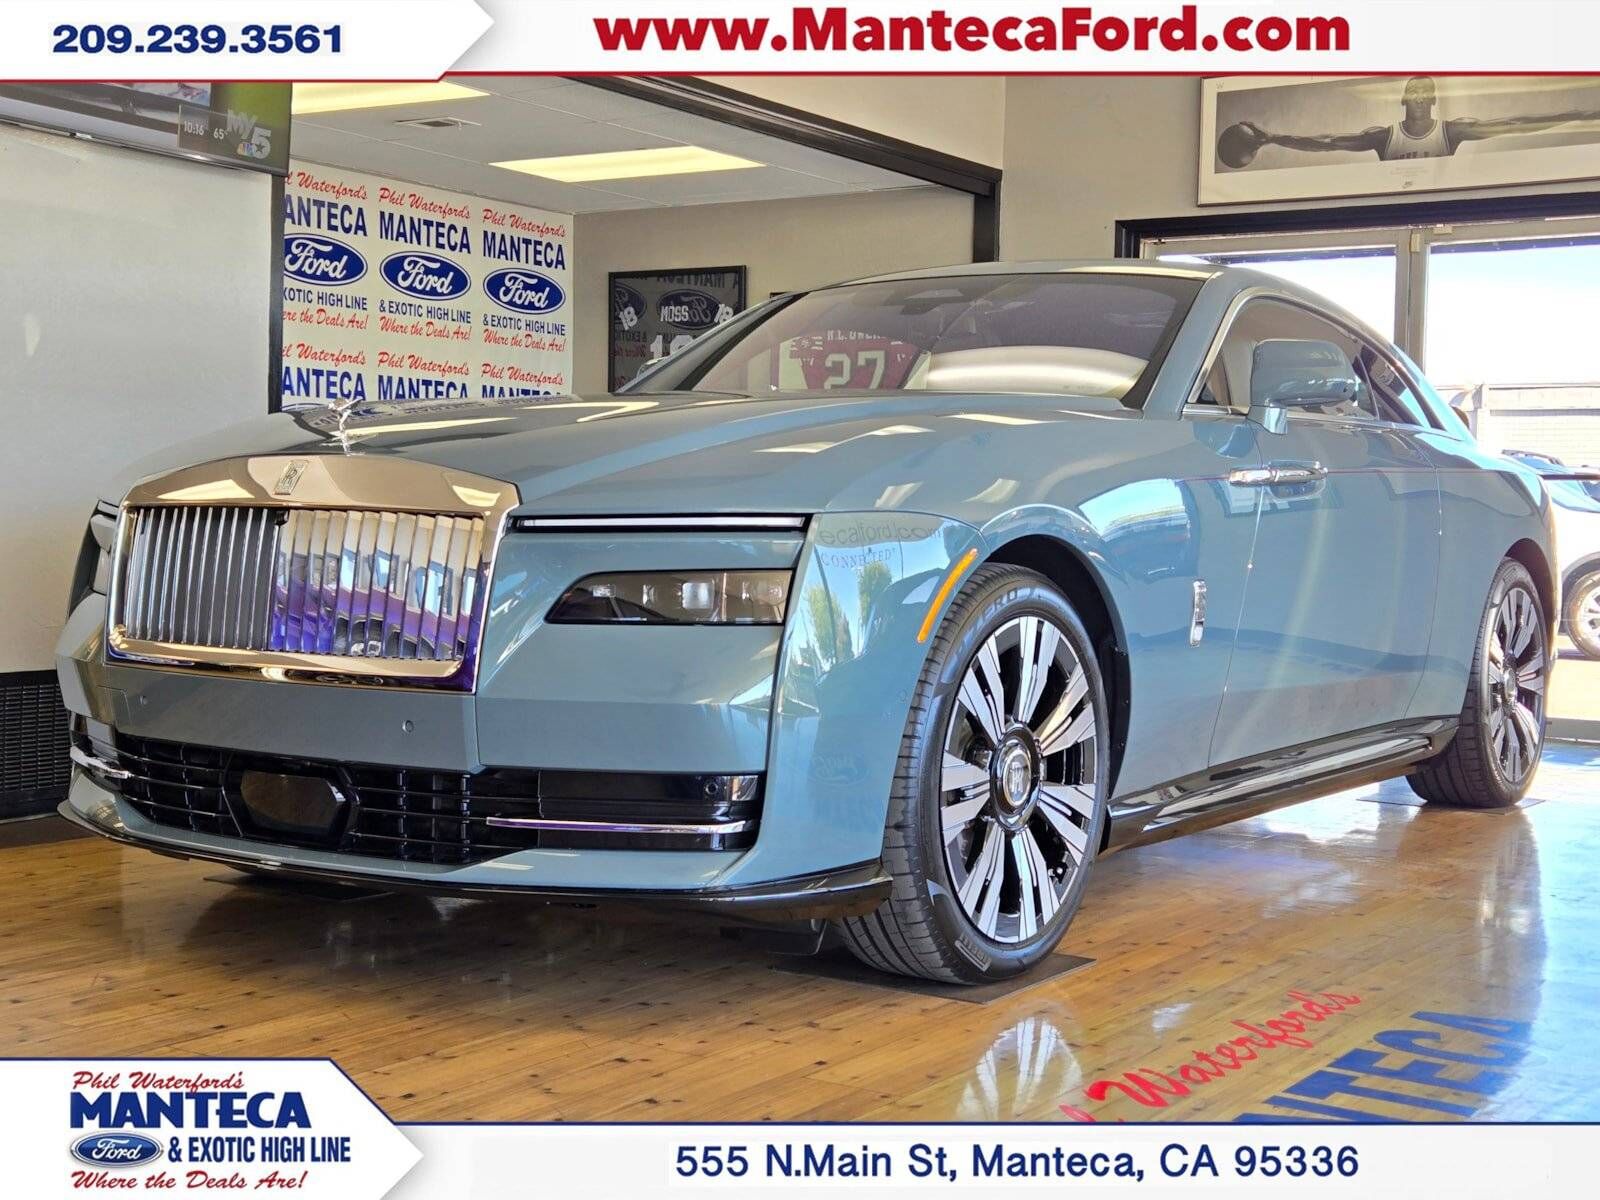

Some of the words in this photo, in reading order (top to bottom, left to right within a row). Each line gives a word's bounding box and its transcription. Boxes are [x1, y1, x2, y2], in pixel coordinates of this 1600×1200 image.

[297, 171, 368, 200] Waterford's
[379, 187, 405, 206] Phil
[409, 193, 471, 219] Waterford's
[379, 210, 471, 255] MANTECA
[483, 208, 506, 226] Phil
[509, 214, 567, 238] Waterford's
[284, 239, 349, 279] Ford
[483, 230, 566, 271] MANTECA
[397, 257, 454, 294] Ford
[317, 291, 343, 307] HIGH
[345, 295, 368, 311] LINE
[499, 273, 550, 308] Ford
[300, 308, 314, 325] the
[316, 308, 345, 328] Deals
[345, 314, 369, 330] Are!
[379, 299, 386, 312] &
[388, 300, 423, 317] EXOTIC
[426, 305, 449, 321] HIGH
[451, 309, 472, 324] LINE
[619, 306, 638, 331] 18
[660, 305, 689, 322] MOSS
[380, 315, 408, 334] Where
[410, 320, 423, 336] the
[425, 321, 450, 339] Deals
[452, 323, 473, 341] Are!
[491, 315, 522, 331] EXOTIC
[525, 319, 545, 334] HIGH
[547, 323, 566, 337] LINE
[484, 328, 509, 345] Where
[511, 332, 523, 348] the
[525, 333, 546, 351] Deals
[547, 337, 567, 353] Are!
[297, 343, 366, 367] Waterford's
[378, 352, 405, 369] Phil
[408, 354, 469, 378] Waterford's
[481, 363, 504, 380] Phil
[507, 366, 564, 387] Waterford's
[824, 350, 886, 390] 27
[378, 374, 468, 400] MANTECA
[1084, 990, 1362, 1109] Waterford's
